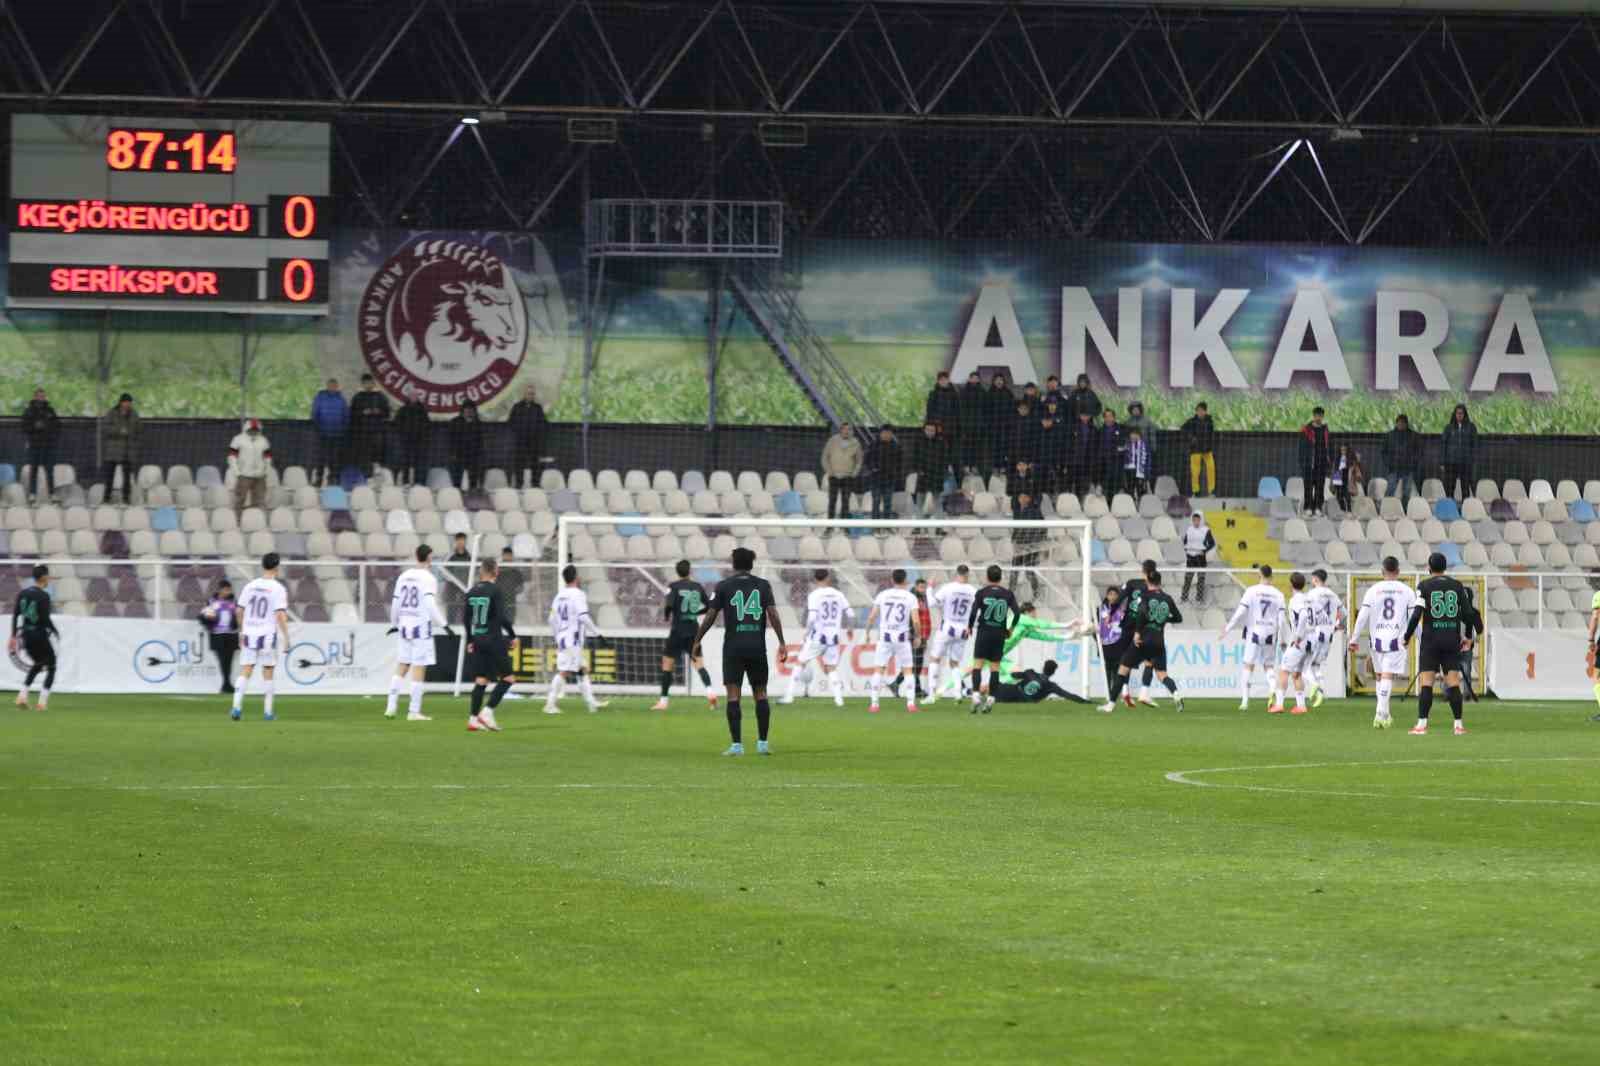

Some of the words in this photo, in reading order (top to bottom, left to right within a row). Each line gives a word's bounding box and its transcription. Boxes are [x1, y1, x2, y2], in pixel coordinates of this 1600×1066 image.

[106, 129, 237, 172] 87:14
[18, 200, 251, 232] KEÇİÖRENGÜCÜ
[283, 195, 315, 239] 0
[50, 265, 219, 295] SERİKSPOR
[283, 257, 314, 301] 0
[364, 262, 404, 343] ANKARA
[948, 283, 1559, 394] ANKARA
[248, 595, 268, 619] 10
[400, 585, 420, 609] 28
[469, 596, 491, 625] 77
[730, 588, 763, 621] 14
[951, 597, 969, 618] 15
[983, 597, 1008, 622] 70
[1259, 599, 1273, 618] 7
[1382, 597, 1395, 620] 8
[1430, 590, 1458, 619] 58
[883, 601, 907, 624] 73
